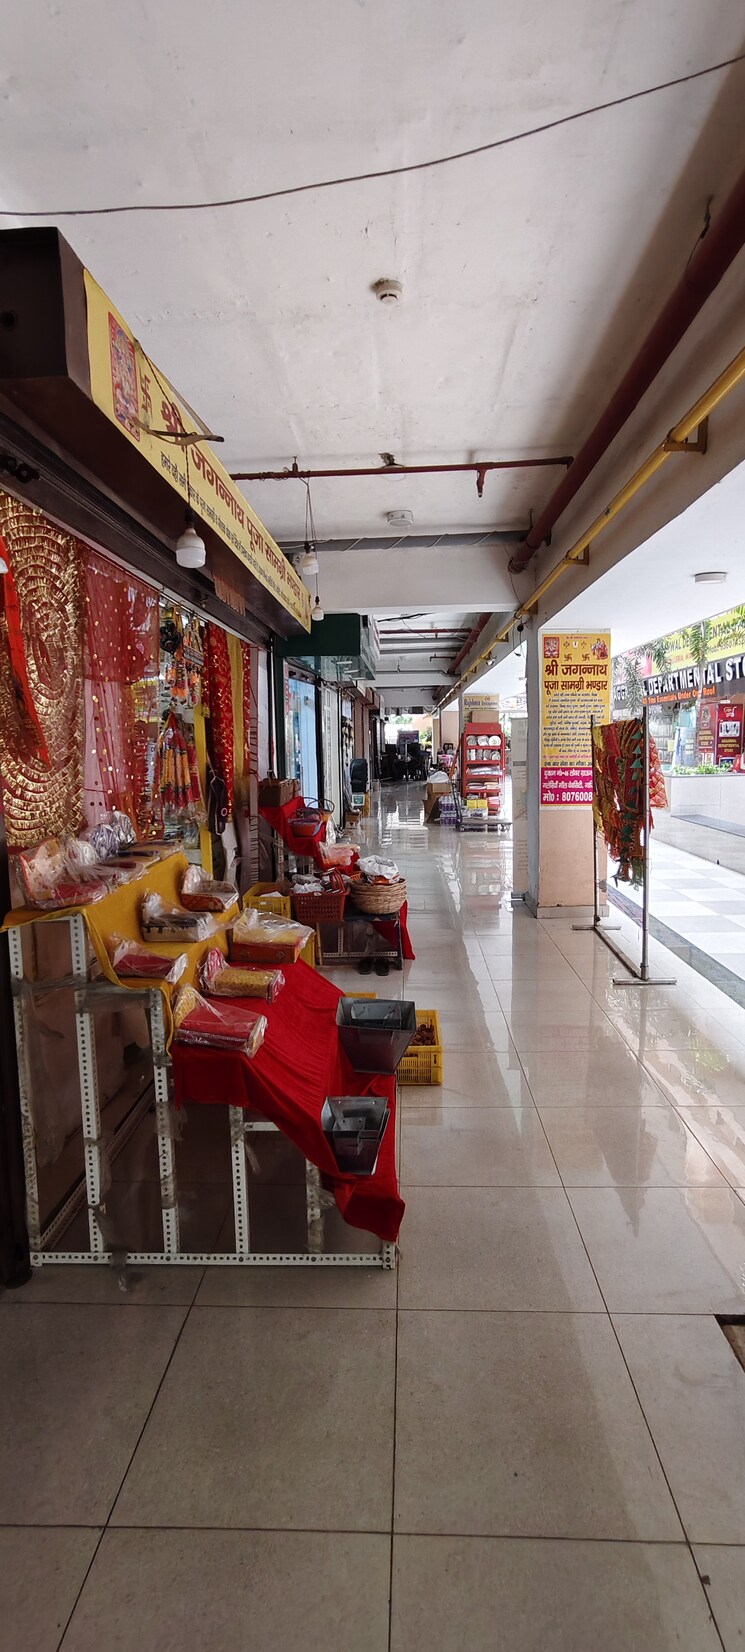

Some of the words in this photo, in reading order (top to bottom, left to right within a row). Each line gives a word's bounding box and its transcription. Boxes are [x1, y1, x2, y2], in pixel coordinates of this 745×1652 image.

[161, 400, 186, 454] श्री
[190, 443, 246, 530] जगन्नाथ
[246, 516, 264, 554] पूजा
[265, 541, 286, 581] सामग्री
[545, 659, 559, 676] श्री
[561, 664, 608, 676] जगन्नाथ
[544, 680, 559, 696] पूजा
[561, 676, 585, 692] सामग्री
[586, 680, 608, 691] भण्डार
[678, 690, 691, 700] Under
[703, 686, 716, 696] Roof
[561, 791, 593, 802] 8076008
